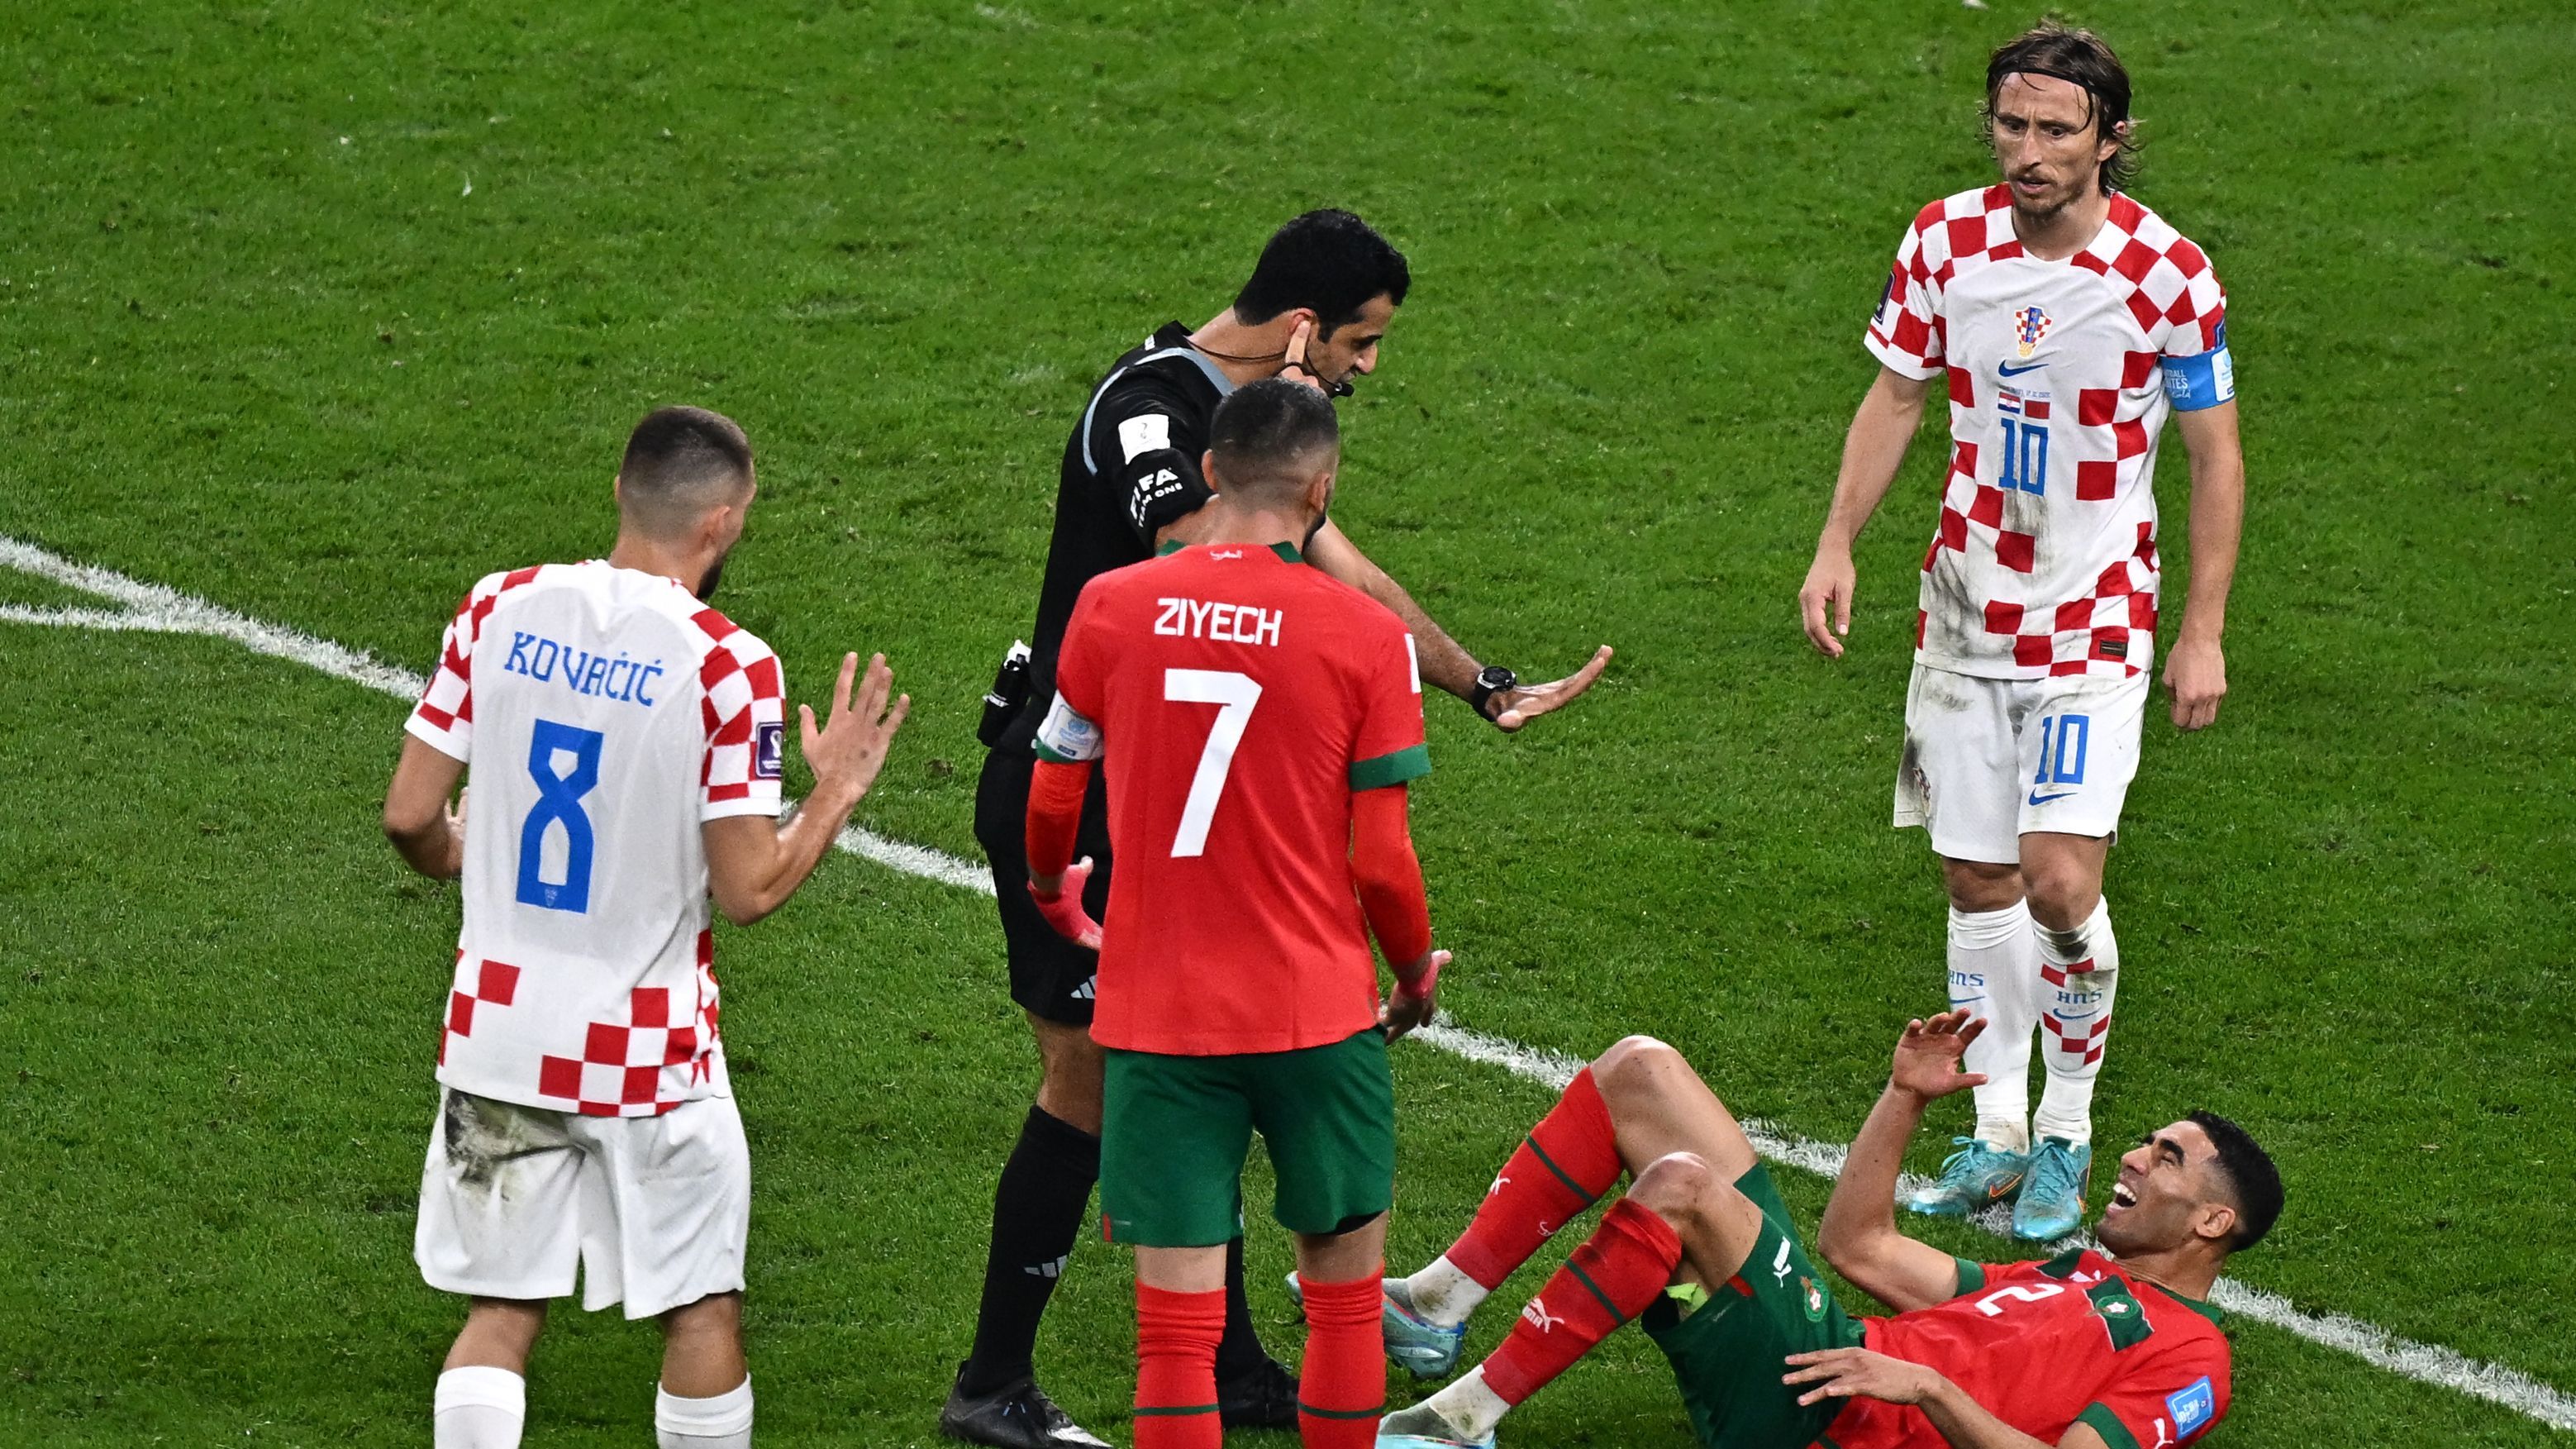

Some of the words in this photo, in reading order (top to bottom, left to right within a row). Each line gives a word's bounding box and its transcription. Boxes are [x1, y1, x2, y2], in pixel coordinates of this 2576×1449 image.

[1998, 417, 2049, 497] 10
[1130, 468, 1179, 520] FIFA
[1155, 482, 1183, 498] ONE
[1155, 598, 1283, 646] ZIYECH
[1164, 668, 1263, 858] 7
[2034, 715, 2089, 784] 10
[517, 718, 603, 913] 8
[1975, 1283, 2065, 1317] 2
